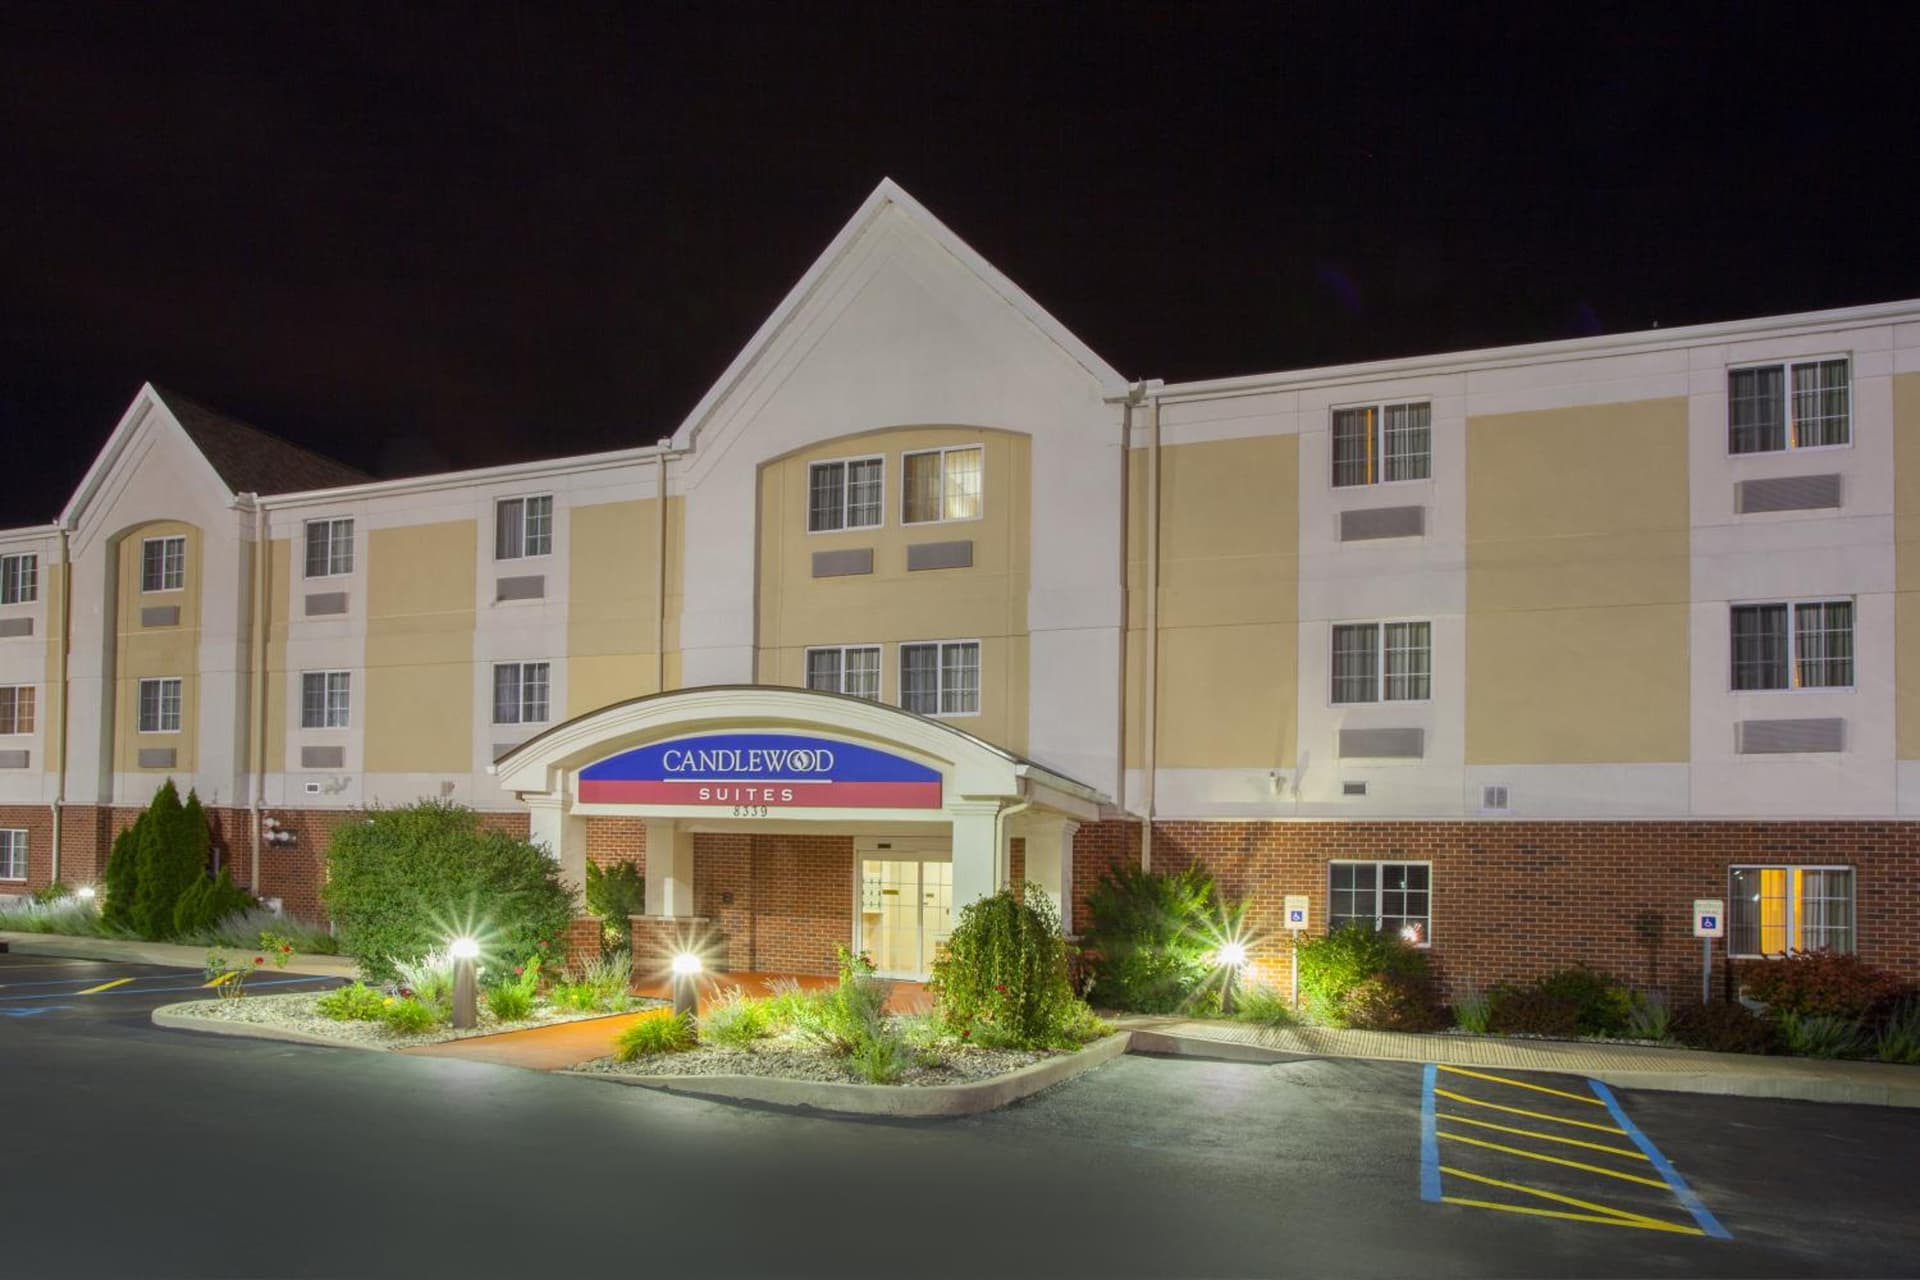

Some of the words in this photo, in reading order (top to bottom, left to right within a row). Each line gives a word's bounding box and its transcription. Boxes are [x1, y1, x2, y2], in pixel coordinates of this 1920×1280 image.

[663, 749, 834, 772] CANDLEWOOD
[699, 787, 793, 801] SUITES
[733, 805, 768, 817] 8339
